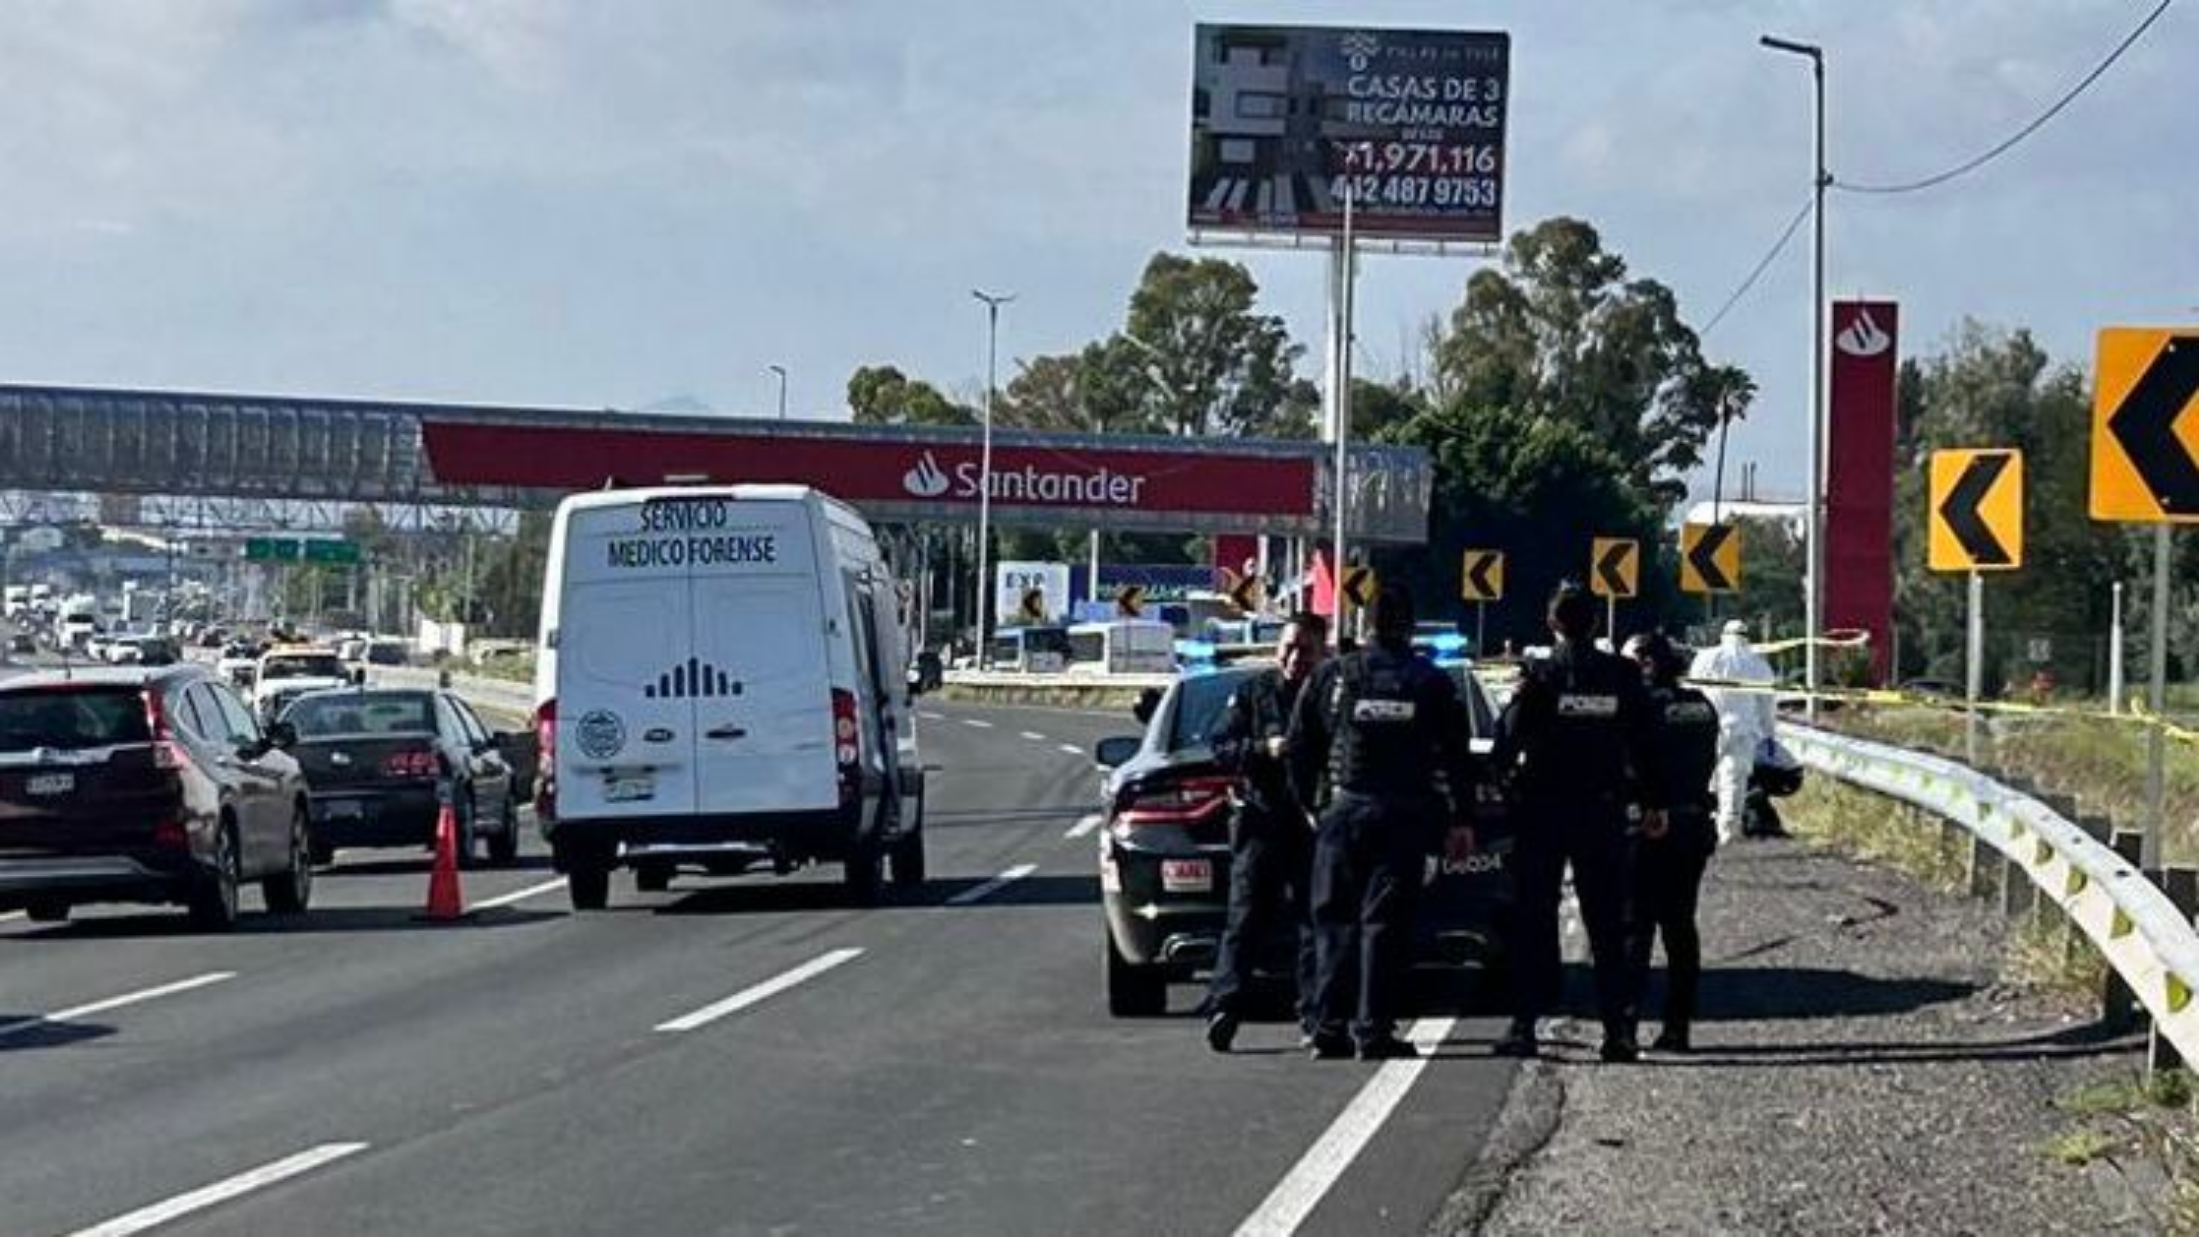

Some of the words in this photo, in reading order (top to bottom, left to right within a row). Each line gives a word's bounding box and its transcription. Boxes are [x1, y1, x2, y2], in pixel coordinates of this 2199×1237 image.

[1348, 74, 1437, 99] CASAS
[1444, 77, 1477, 101] DE
[1484, 78, 1500, 102] 3
[1384, 175, 1429, 203] 487
[1433, 177, 1495, 206] 9753
[955, 462, 1146, 502] Santander
[640, 500, 727, 532] SERVICIO
[608, 538, 685, 567] MEDICO
[687, 535, 776, 564] FORENSE
